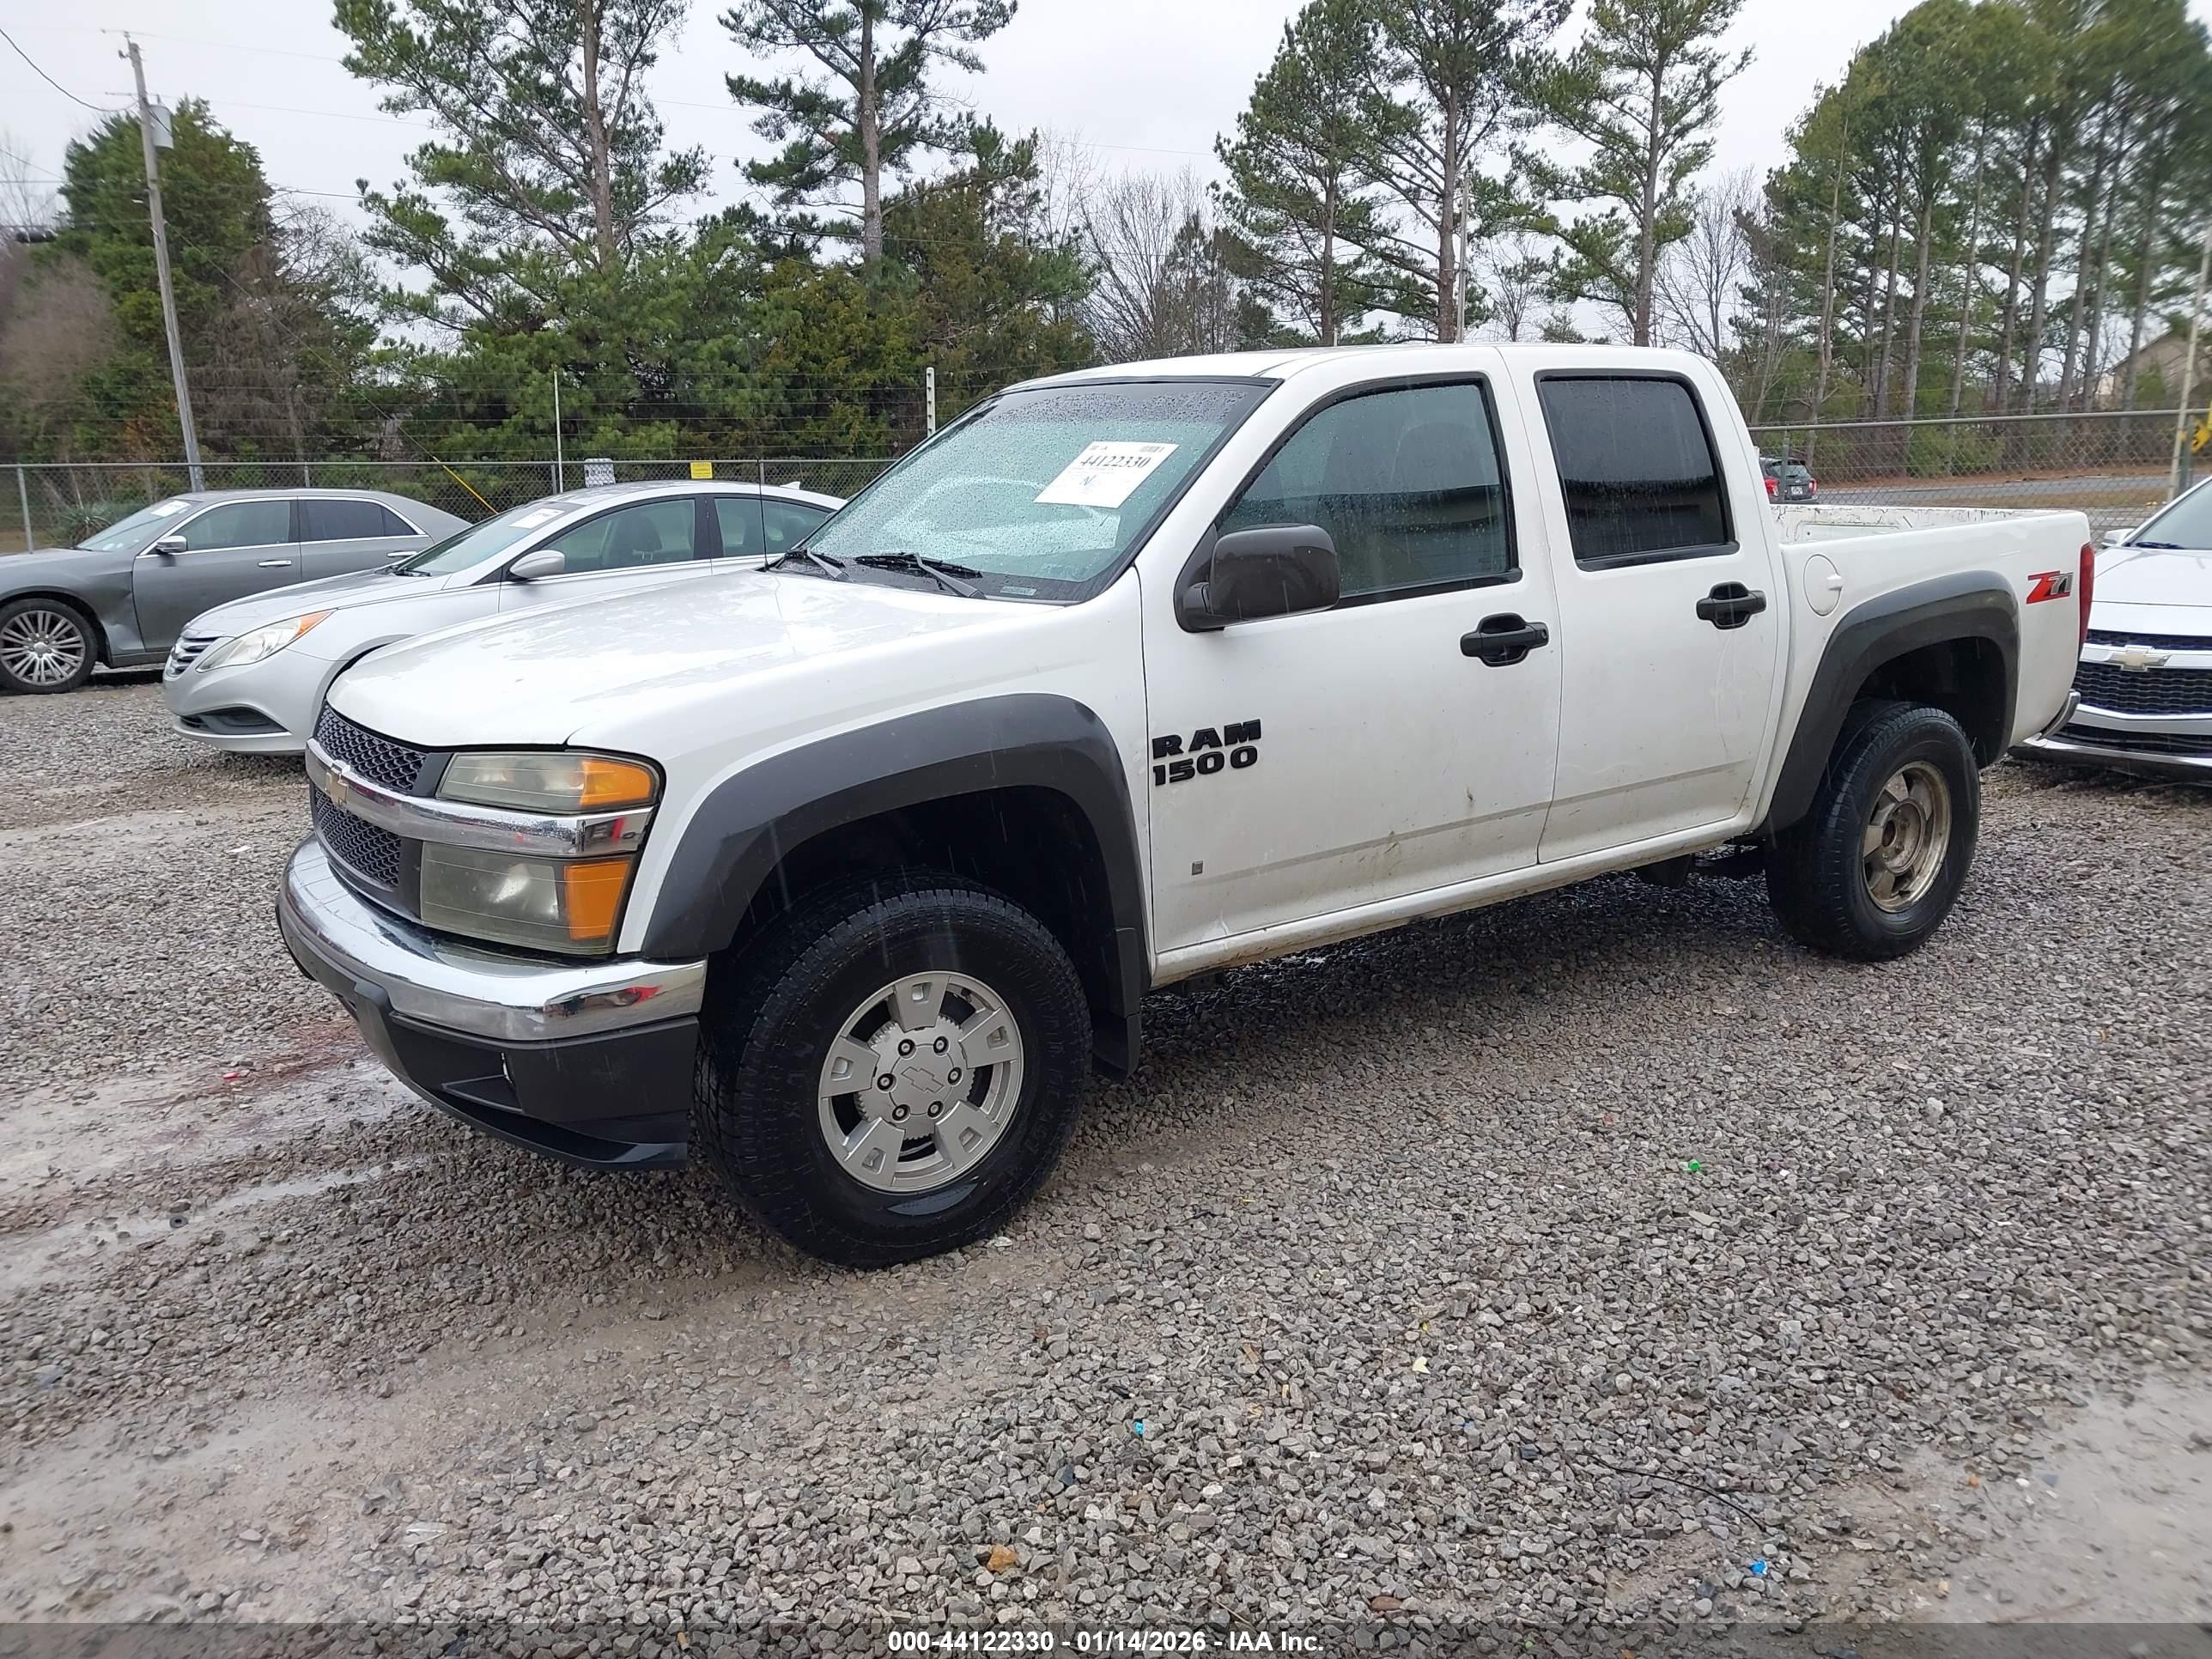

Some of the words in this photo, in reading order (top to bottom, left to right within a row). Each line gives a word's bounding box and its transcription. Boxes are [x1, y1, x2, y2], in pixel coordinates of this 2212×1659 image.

[1079, 455, 1152, 468] 44122330
[2026, 570, 2075, 605] Z71
[1152, 718, 1261, 760] RAM
[1152, 745, 1258, 787] 1500
